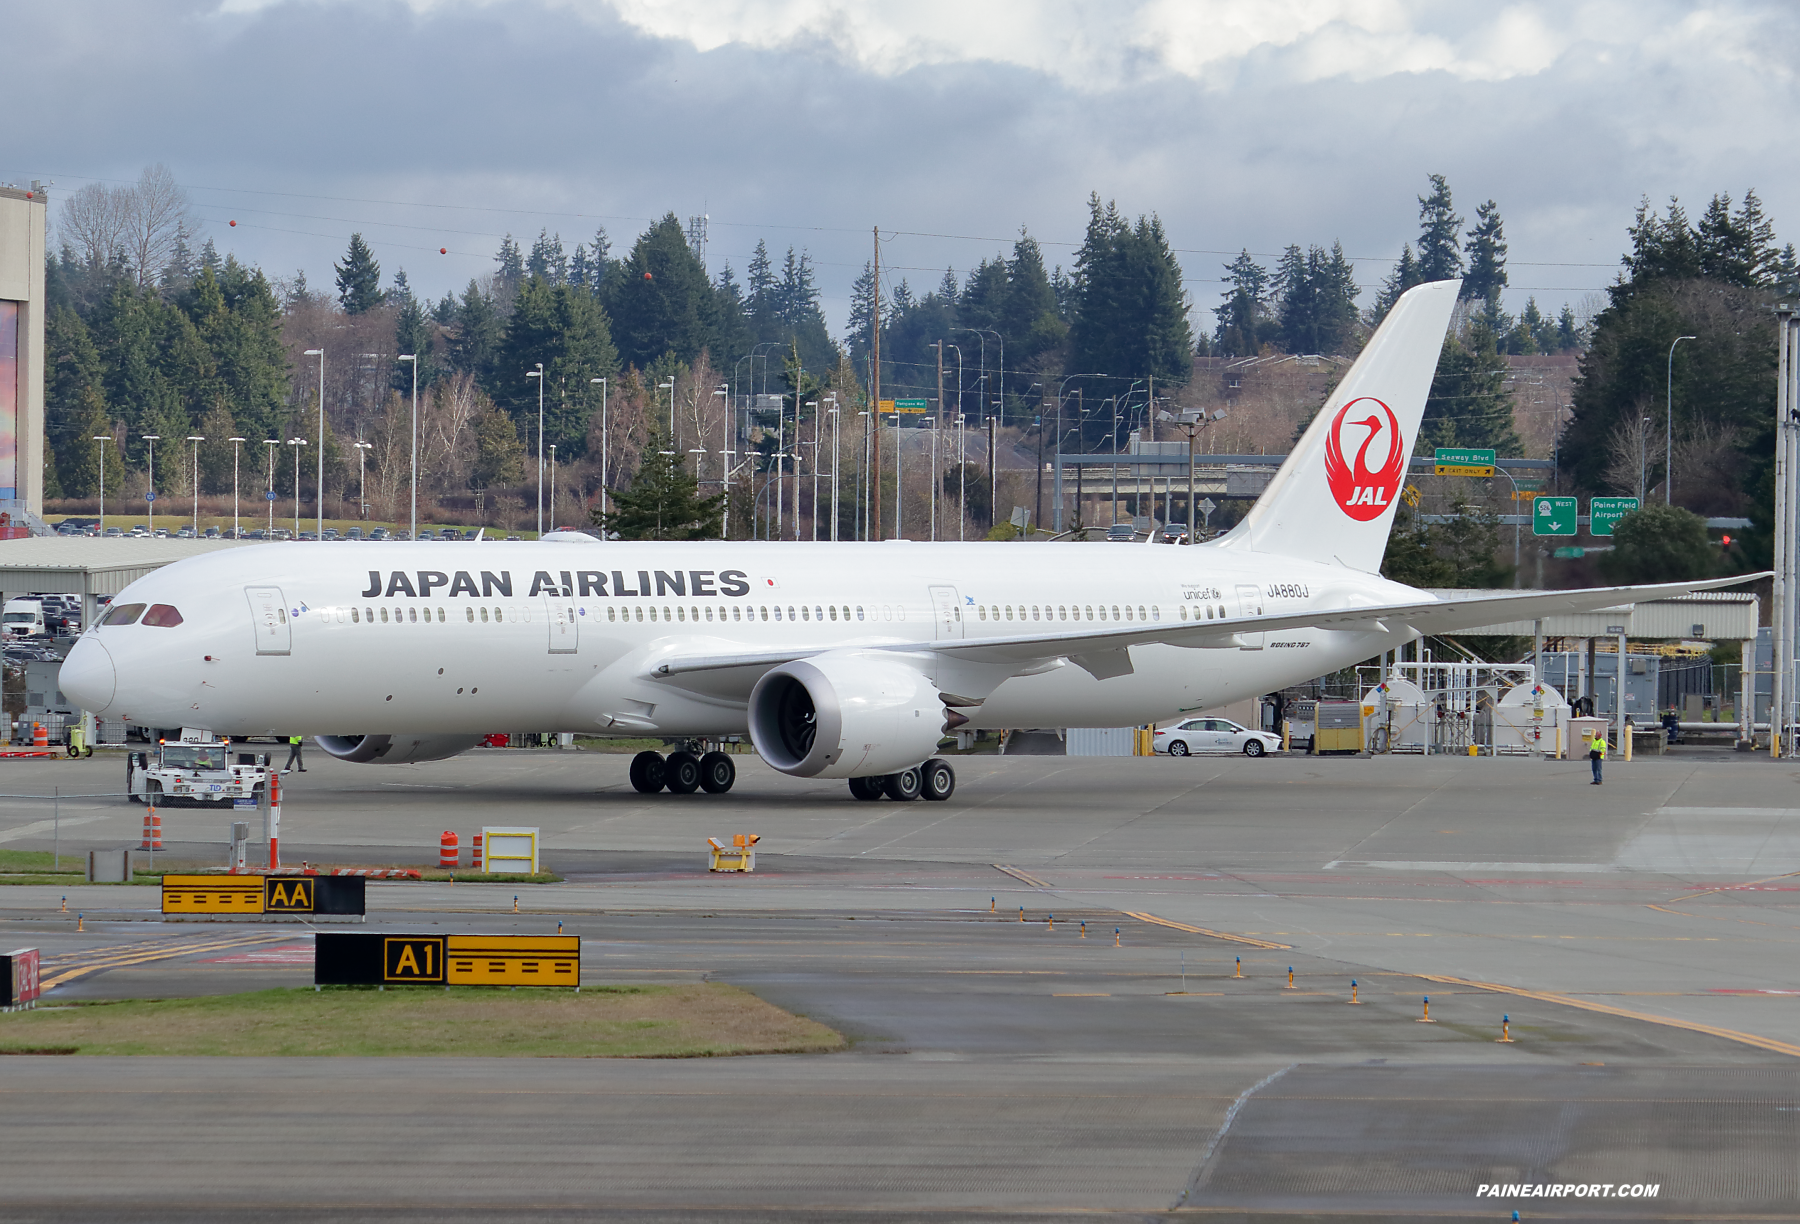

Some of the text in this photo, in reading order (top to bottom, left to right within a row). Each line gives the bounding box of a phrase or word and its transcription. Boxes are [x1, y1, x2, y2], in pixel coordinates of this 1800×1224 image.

[1441, 454, 1469, 462] Seaway
[1346, 486, 1387, 505] JAL
[1593, 501, 1636, 509] Paine Field
[1594, 511, 1623, 519] Airport
[362, 569, 750, 598] JAPAN AIRLINES
[1183, 587, 1211, 600] unicef
[1267, 584, 1309, 598] JA880J
[209, 784, 222, 792] TLD
[270, 882, 309, 906] AA
[395, 944, 432, 975] A1
